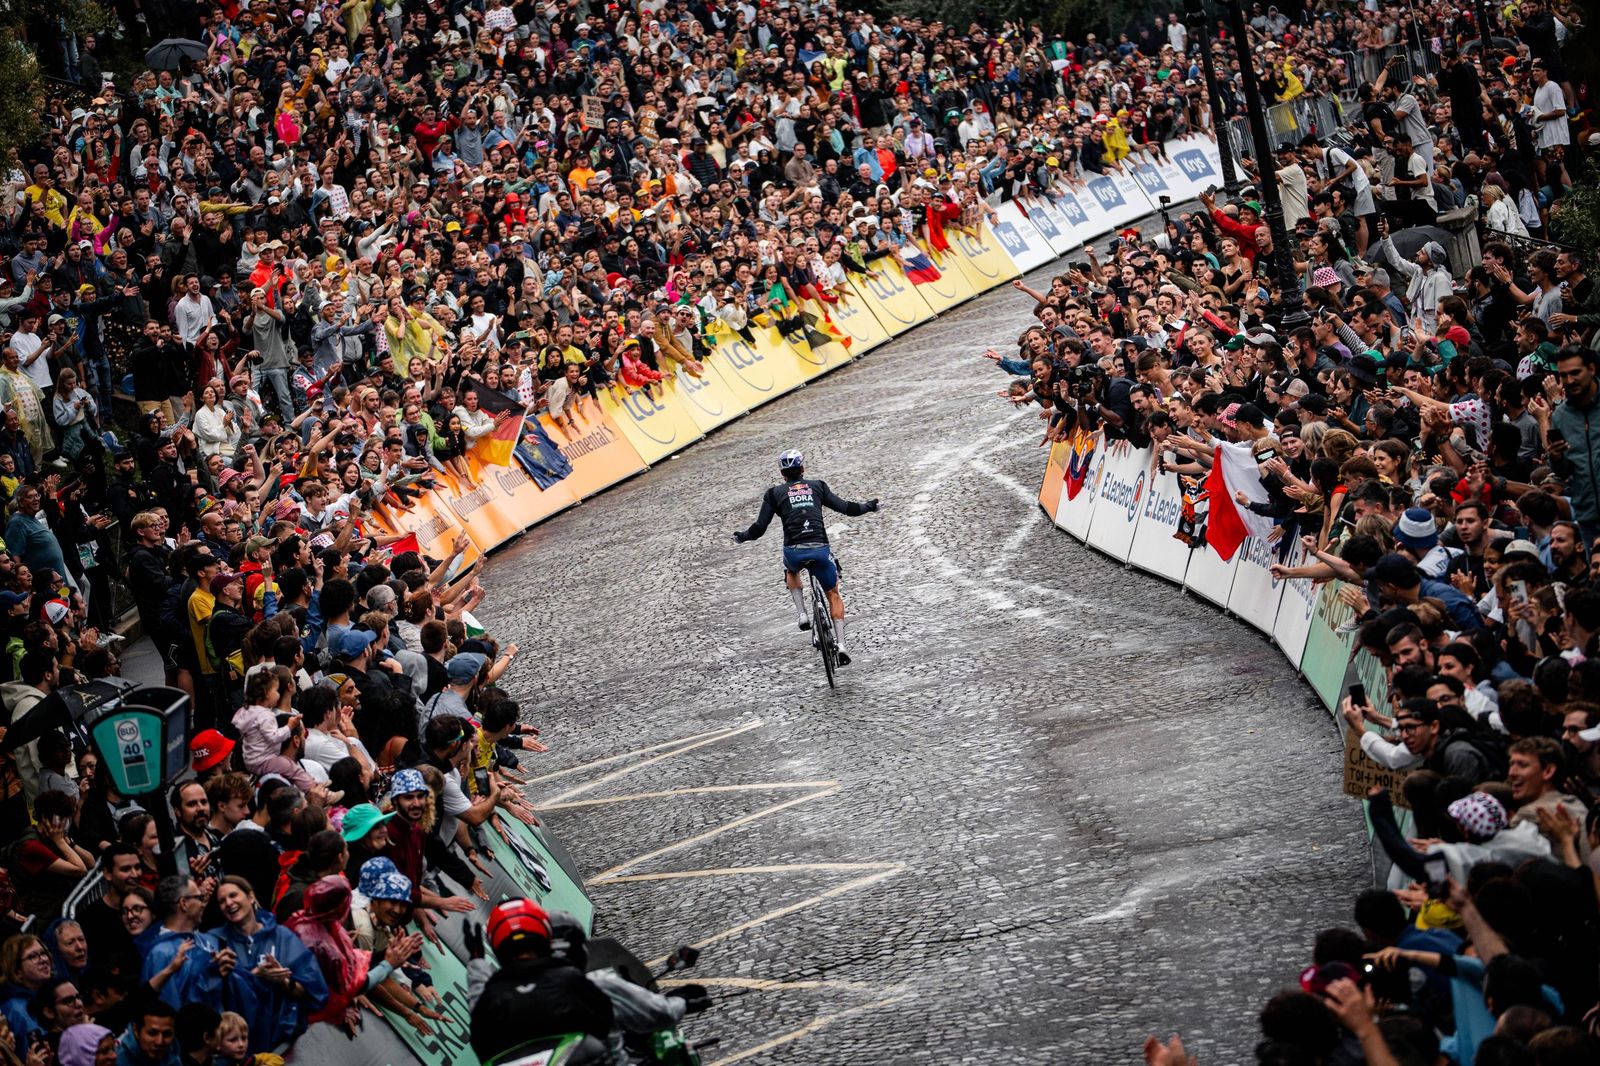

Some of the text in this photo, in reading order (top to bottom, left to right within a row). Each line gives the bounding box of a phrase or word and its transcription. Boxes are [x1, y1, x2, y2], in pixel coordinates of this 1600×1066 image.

[1180, 156, 1206, 174] Krys
[1098, 183, 1118, 202] Krys
[867, 269, 905, 300] LCL
[721, 340, 764, 371] LCL
[621, 388, 666, 422] LCL
[561, 426, 612, 462] ontinental
[789, 495, 814, 504] BORA
[1100, 471, 1132, 509] E.Leclerc
[1144, 489, 1181, 527] E.Lecler
[119, 728, 136, 736] BUS
[124, 744, 140, 755] 40
